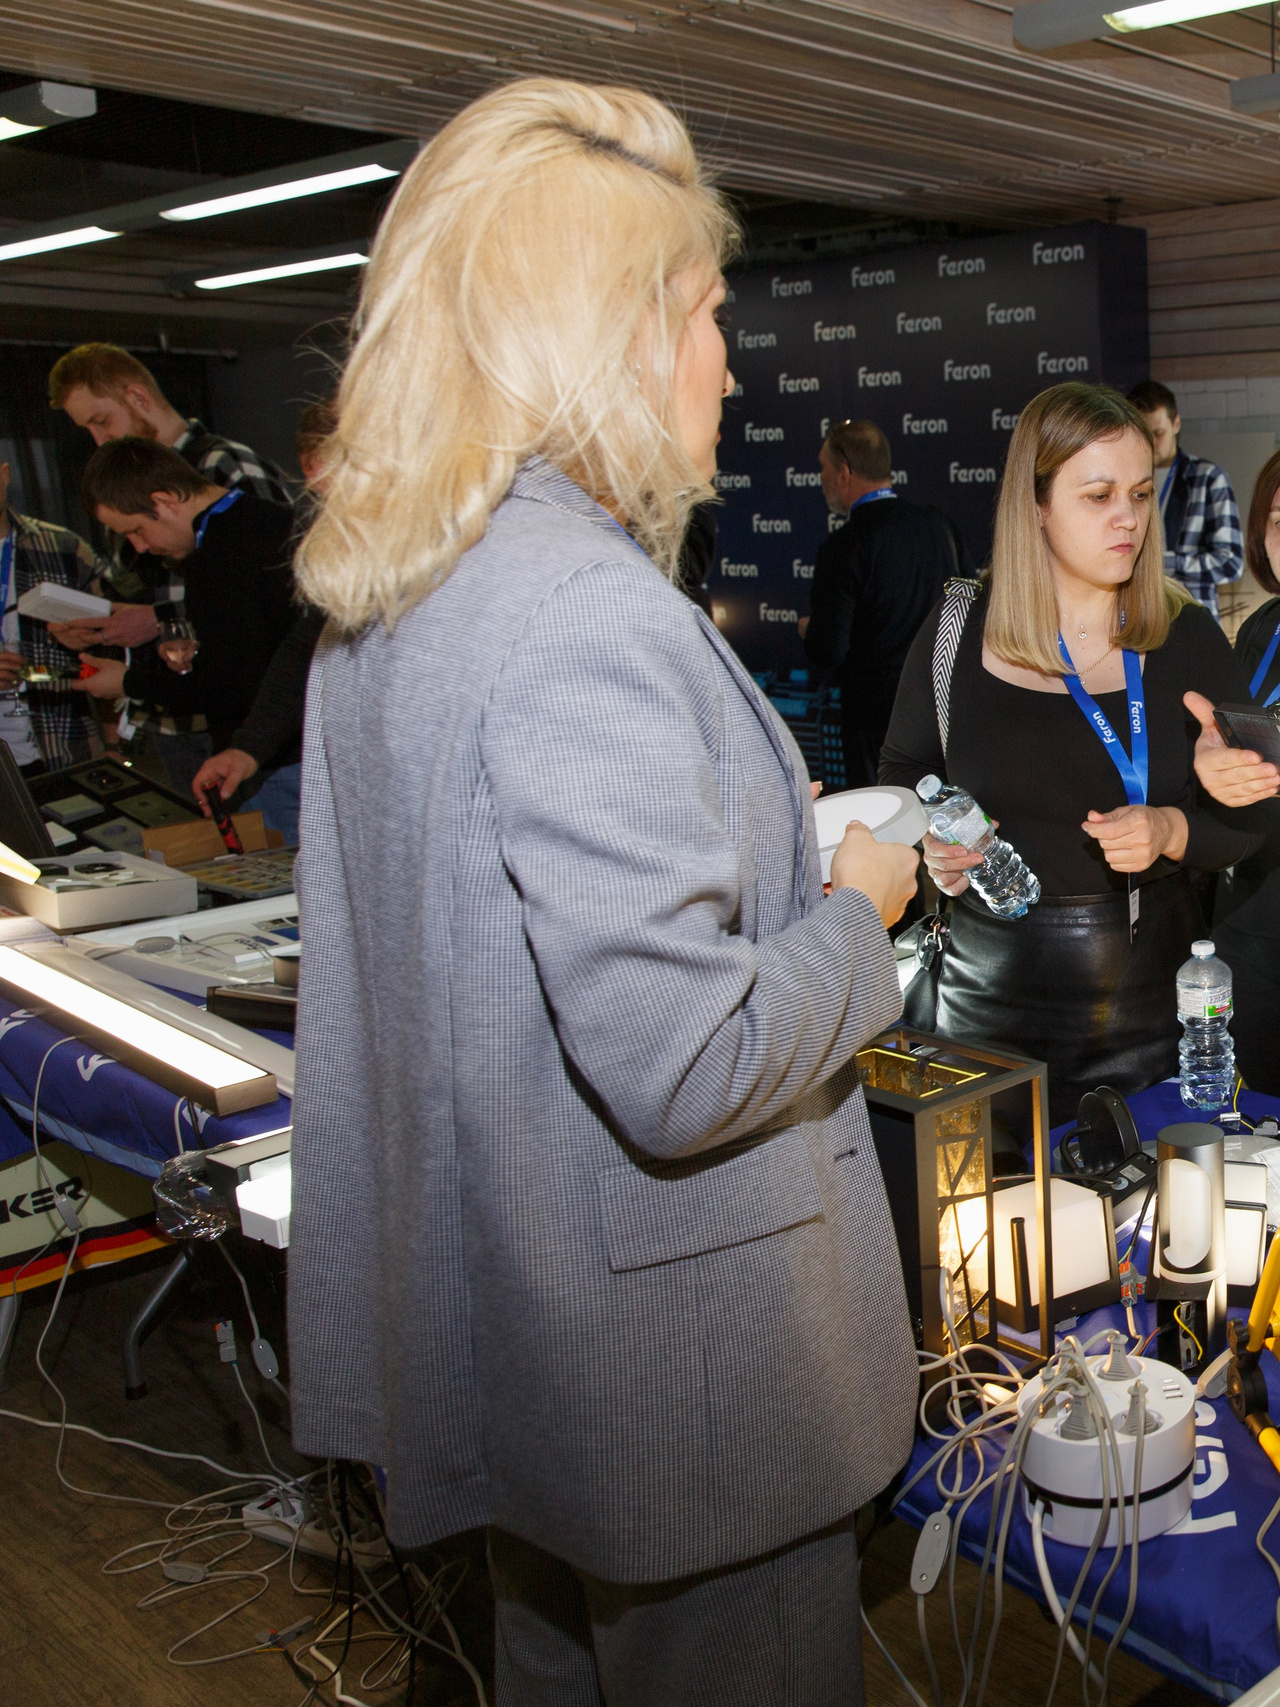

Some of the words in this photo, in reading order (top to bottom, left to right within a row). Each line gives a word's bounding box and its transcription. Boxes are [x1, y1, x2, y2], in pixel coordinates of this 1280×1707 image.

[1033, 242, 1084, 265] Feron
[939, 255, 985, 277] Feron
[772, 277, 812, 298] Feron
[852, 267, 895, 288] Feron
[897, 314, 941, 333] Feron
[986, 303, 1036, 325] Feron
[738, 331, 776, 349] Feron
[814, 322, 856, 341] Feron
[944, 360, 990, 381] Feron
[1037, 352, 1088, 374] Feron
[779, 374, 819, 393] Feron
[858, 367, 901, 387] Feron
[903, 414, 948, 434] Feron
[992, 409, 1019, 430] Fer
[745, 423, 784, 442] Feron
[950, 462, 995, 483] Feron
[753, 514, 791, 533] Feron
[721, 559, 757, 577] Feron
[793, 559, 814, 578] Fer
[760, 603, 797, 623] Feron
[1131, 701, 1143, 733] Feron
[1093, 712, 1116, 744] Feron
